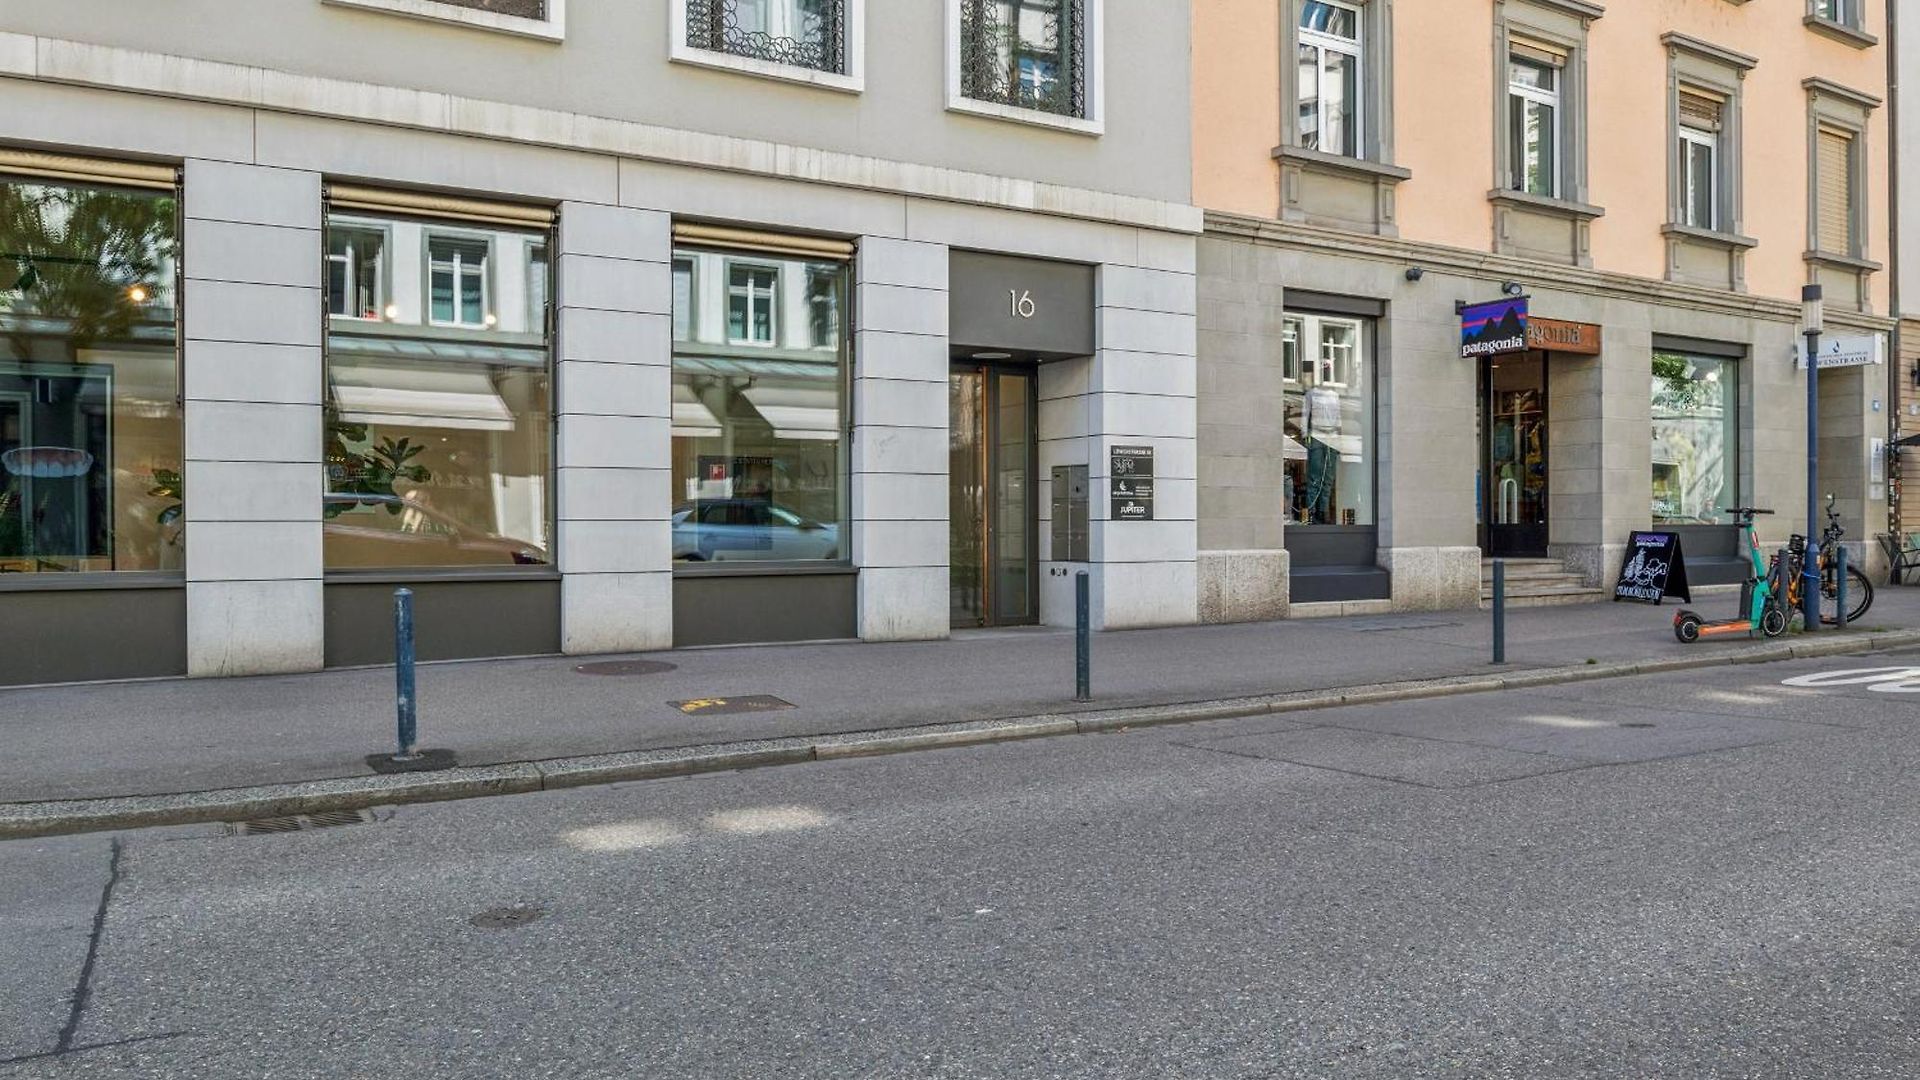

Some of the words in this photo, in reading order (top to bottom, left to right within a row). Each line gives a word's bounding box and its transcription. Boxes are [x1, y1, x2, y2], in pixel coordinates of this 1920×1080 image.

[1010, 290, 1035, 318] 16
[1462, 335, 1523, 356] patagonia
[1120, 506, 1145, 514] JUPITER
